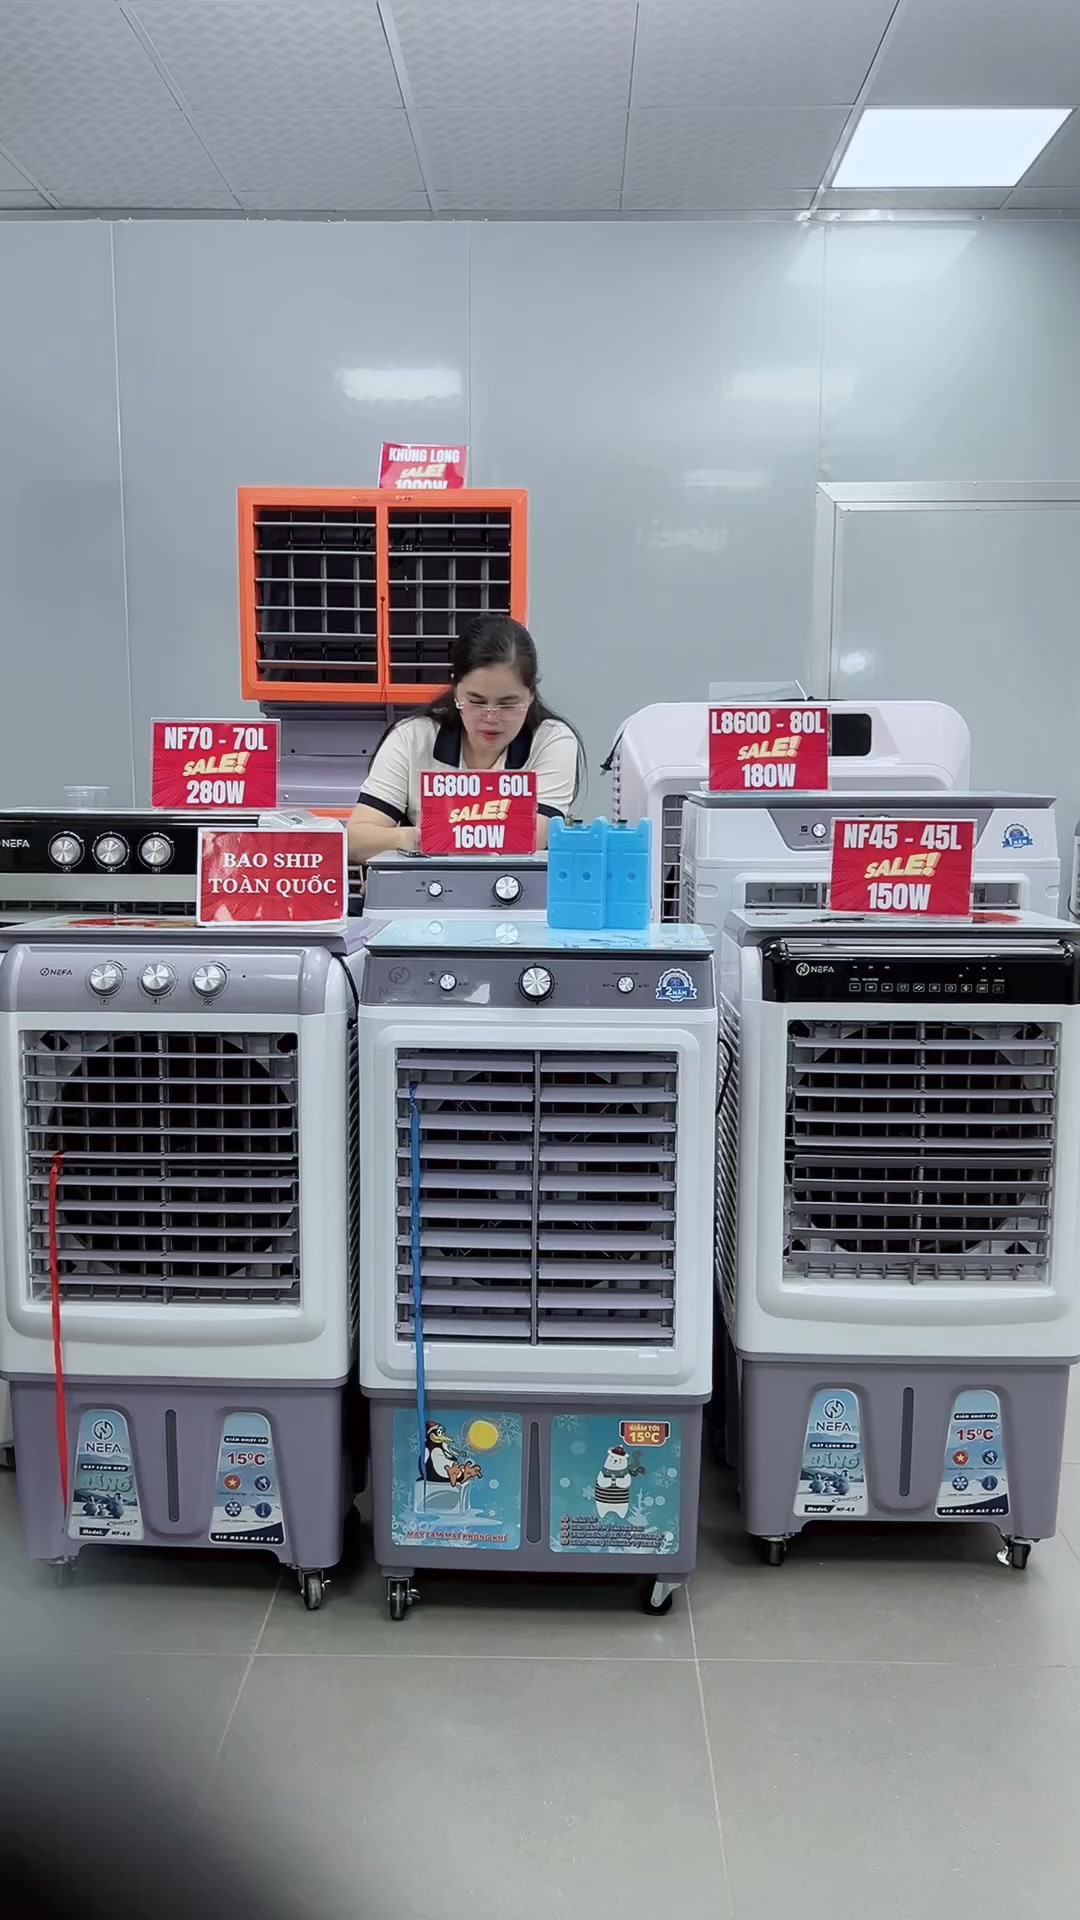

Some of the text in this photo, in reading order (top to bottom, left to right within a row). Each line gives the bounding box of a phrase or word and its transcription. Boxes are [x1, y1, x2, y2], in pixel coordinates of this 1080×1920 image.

[430, 449, 460, 463] LONG
[711, 711, 771, 734] L8600
[790, 711, 825, 734] 80L
[164, 726, 213, 750] NF70
[232, 727, 269, 751] 70L
[736, 735, 803, 761] SALE!
[182, 751, 251, 777] SALE!
[741, 763, 797, 788] 180W
[186, 780, 246, 804] 280W
[423, 774, 480, 797] L6800
[499, 774, 533, 797] 60L
[448, 798, 512, 824] SALE!
[2, 839, 30, 849] NEFA
[452, 825, 506, 849] 160W
[843, 823, 899, 849] NF45
[920, 825, 963, 851] 45L
[223, 853, 324, 869] BAO SHIP
[863, 851, 942, 879] SALE!
[208, 874, 337, 899] TOÀN QUỐC
[867, 882, 932, 911] 150W
[50, 968, 74, 976] NEFA
[810, 965, 835, 974] NEFA
[665, 986, 673, 996] 2
[815, 1420, 852, 1432] NEFA
[85, 1441, 122, 1454] NEFA
